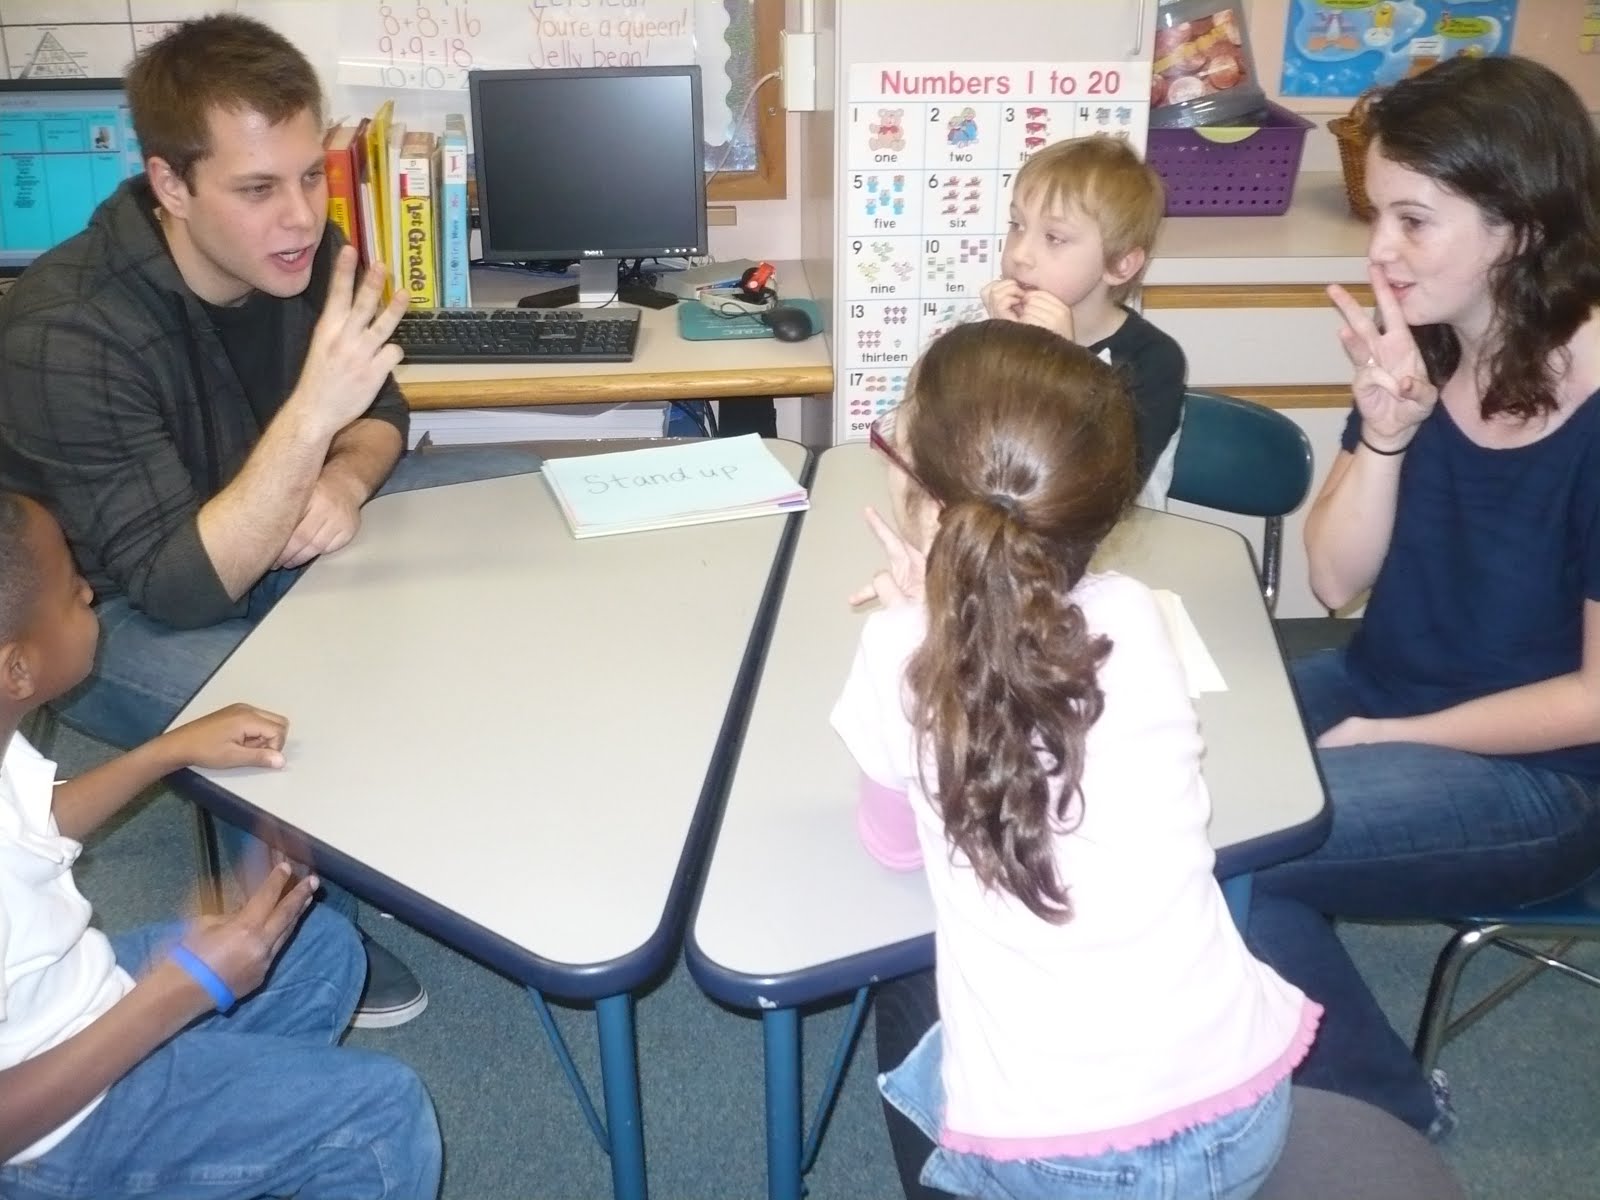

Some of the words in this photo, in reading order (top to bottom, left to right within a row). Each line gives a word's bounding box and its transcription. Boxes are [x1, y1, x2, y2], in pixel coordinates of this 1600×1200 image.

[528, 6, 593, 37] Youre
[600, 19, 611, 37] a
[618, 8, 688, 45] queen!
[528, 38, 582, 69] Jelly
[592, 38, 650, 67] bean!
[881, 70, 1011, 95] Numbers
[1051, 70, 1077, 95] to
[1088, 70, 1121, 94] 20
[930, 107, 940, 122] 2
[1005, 107, 1015, 122] 3
[1080, 107, 1089, 121] 4
[874, 153, 898, 163] one
[949, 152, 973, 163] two
[853, 175, 863, 189] 5
[928, 174, 938, 189] 6
[1002, 173, 1012, 188] 7
[874, 217, 896, 229] five
[950, 218, 967, 229] six
[852, 240, 863, 254] 9
[925, 239, 940, 253] 10
[407, 229, 426, 292] Grade
[870, 284, 896, 294] nine
[946, 282, 964, 293] ten
[851, 305, 865, 318] 13
[923, 302, 937, 316] 14
[862, 352, 908, 363] thirteen
[850, 372, 864, 386] 17
[584, 466, 692, 495] Stand
[699, 464, 739, 481] up
